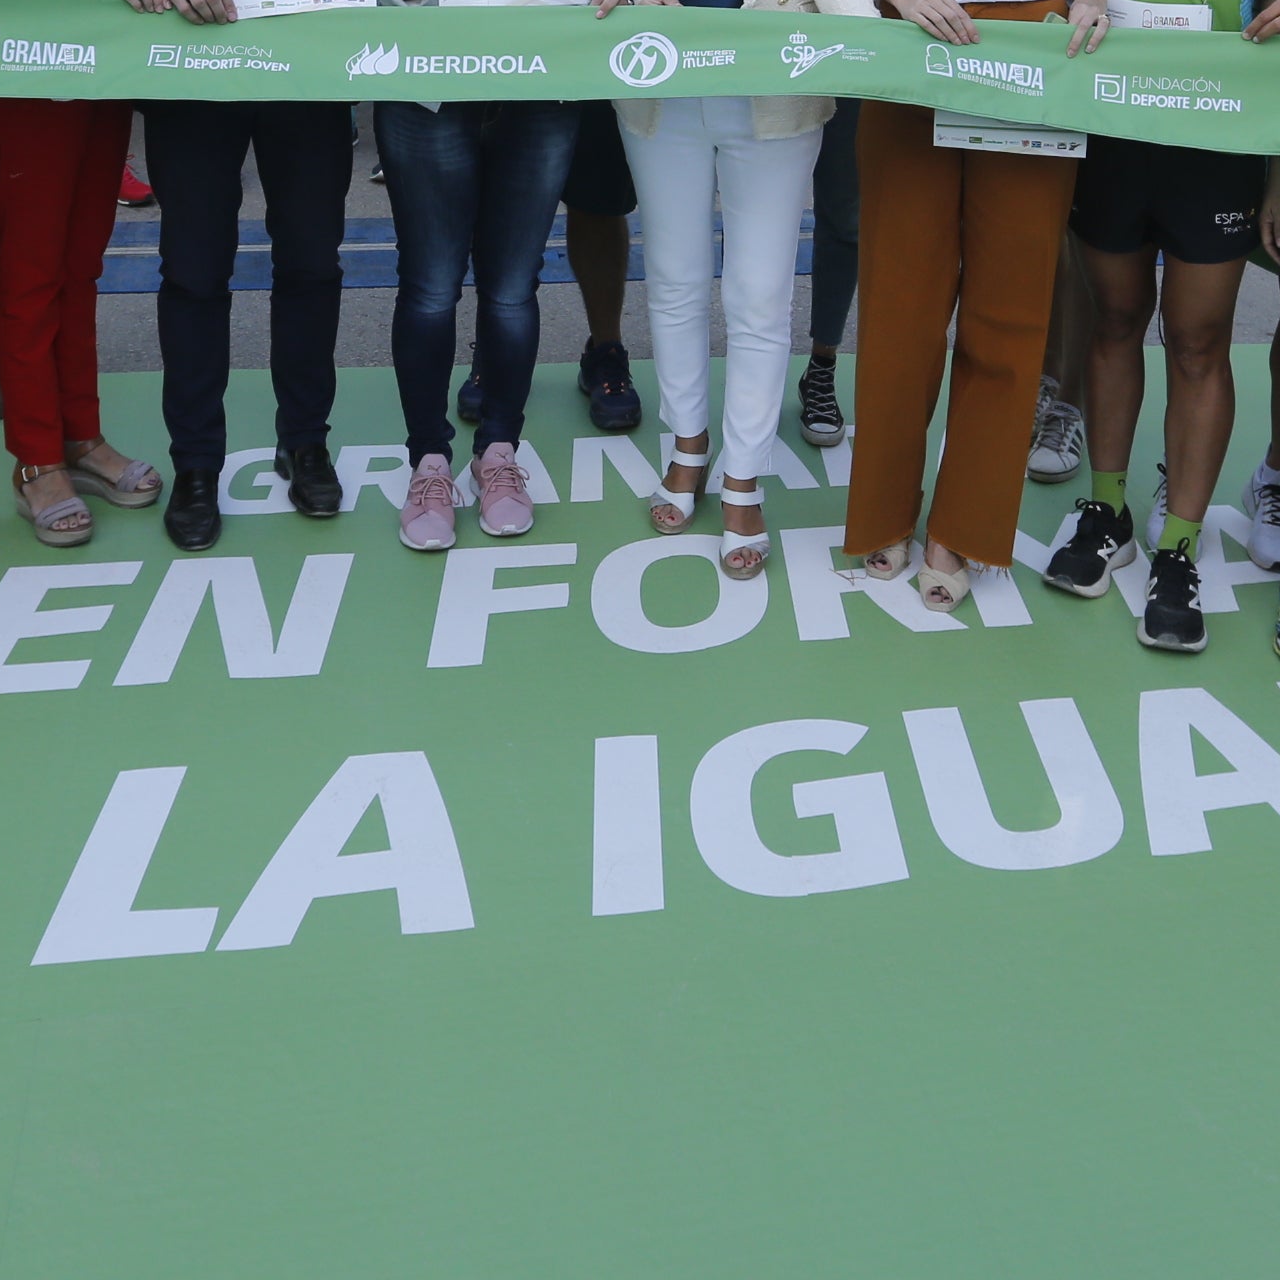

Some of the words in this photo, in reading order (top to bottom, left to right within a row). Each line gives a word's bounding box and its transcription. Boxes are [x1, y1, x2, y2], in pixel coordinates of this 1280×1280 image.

[1, 38, 96, 66] GRANADA
[186, 44, 272, 58] FUNDACIÓN
[682, 49, 737, 58] UNIVERSO
[780, 45, 815, 64] CSD
[184, 57, 241, 70] DEPORTE
[244, 58, 290, 72] JOVEN
[405, 55, 548, 74] IBERDROLA
[682, 55, 736, 69] MUJER
[956, 57, 1044, 90] GRANADA
[1131, 75, 1221, 93] FUNDACIÓN
[1130, 93, 1190, 110] DEPORTE
[1193, 94, 1241, 112] JOVEN
[31, 750, 476, 966] LA
